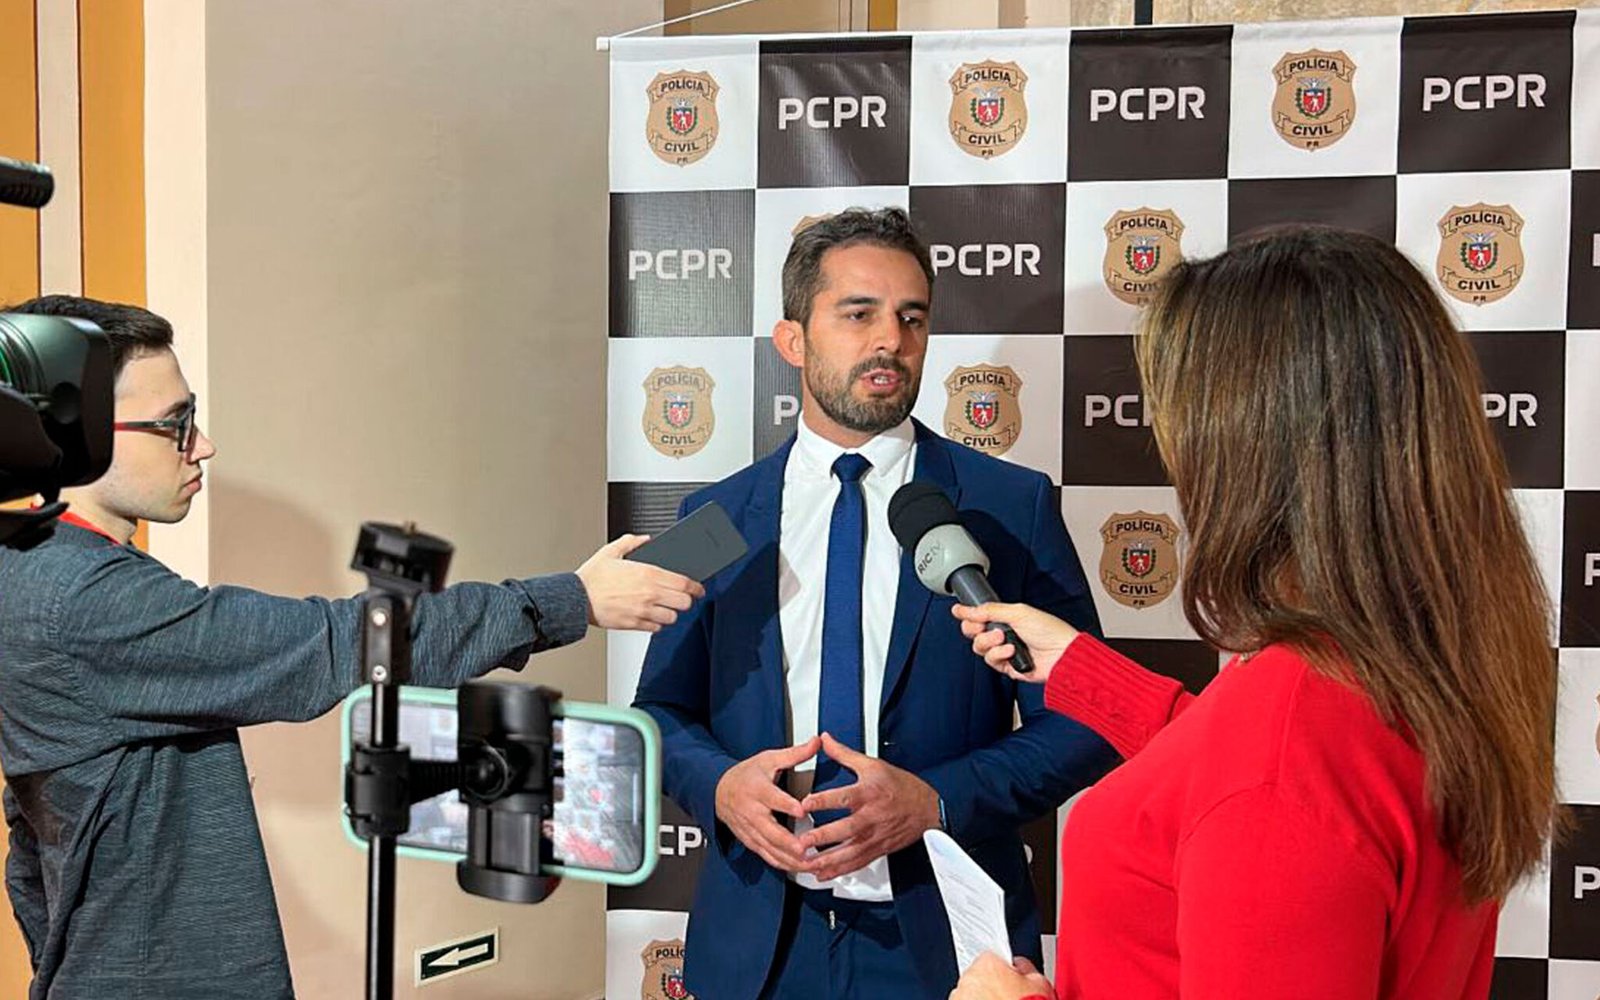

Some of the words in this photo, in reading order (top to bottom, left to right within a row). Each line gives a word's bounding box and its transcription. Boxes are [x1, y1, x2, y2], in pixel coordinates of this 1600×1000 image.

[1289, 57, 1339, 73] POLÍCIA
[964, 68, 1011, 83] POLÍCIA
[660, 77, 704, 92] POLÍCIA
[1422, 73, 1547, 112] PCPR
[1090, 86, 1206, 122] PCPR
[778, 96, 887, 130] PCPR
[1292, 125, 1333, 136] CIVIL
[968, 133, 1006, 145] CIVIL
[664, 141, 700, 152] CIVIL
[1120, 216, 1168, 230] POLÍCIA
[1455, 212, 1506, 226] POLÍCIA
[628, 248, 733, 281] PCPR
[929, 243, 1041, 276] PCPR
[1457, 280, 1501, 290] CIVIL
[657, 372, 700, 387] POLÍCIA
[960, 372, 1006, 386] POLÍCIA
[661, 435, 696, 445] CIVIL
[963, 436, 1001, 447] CIVIL
[1116, 521, 1164, 534] POLÍCIA
[1119, 584, 1158, 595] CIVIL
[657, 824, 707, 857] CP
